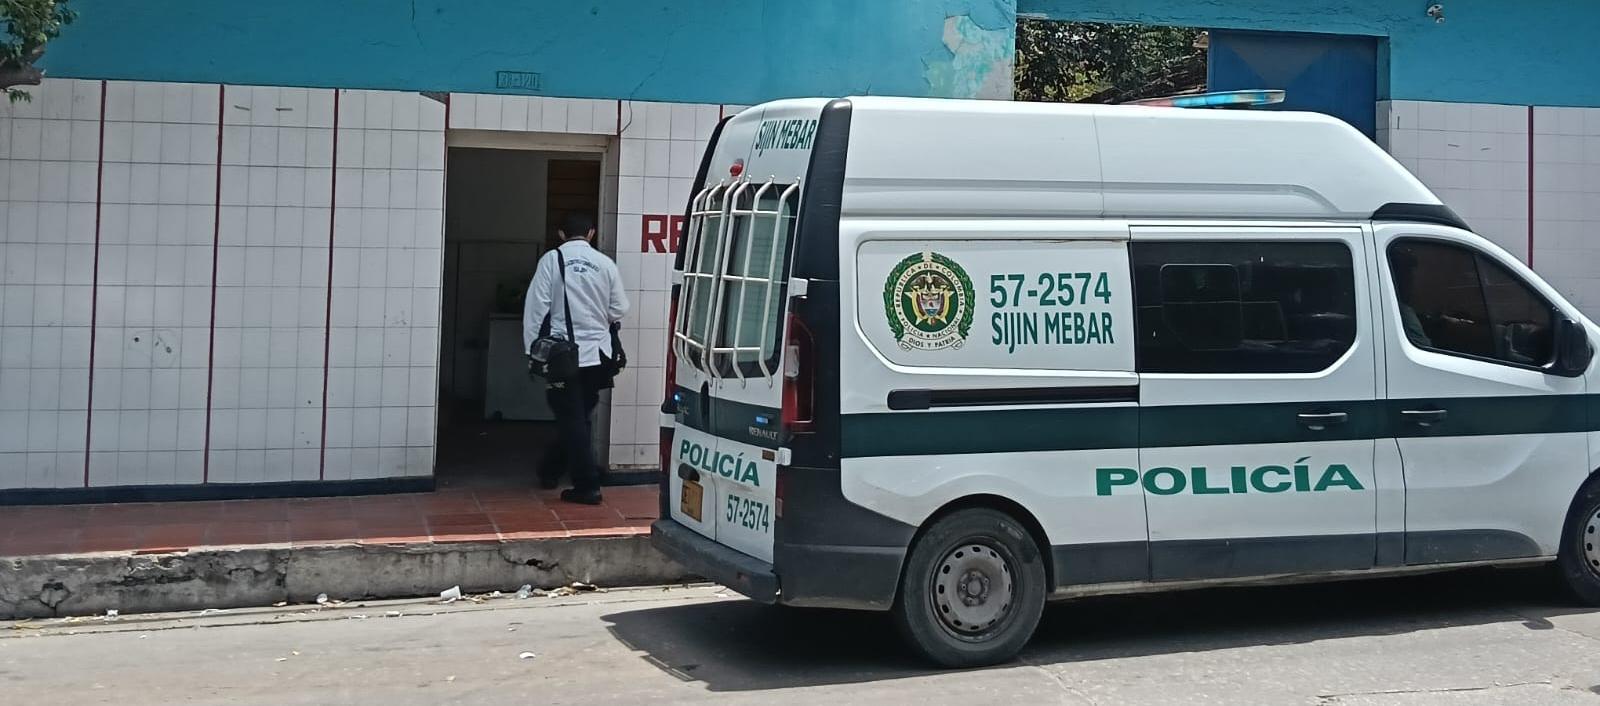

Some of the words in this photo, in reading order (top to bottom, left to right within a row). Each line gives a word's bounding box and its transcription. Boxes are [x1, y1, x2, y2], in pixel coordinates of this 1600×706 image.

[755, 121, 779, 157] SIJIN
[776, 120, 817, 149] MEBAR
[941, 267, 965, 306] COLOMBIA
[990, 272, 1112, 308] 57-2574
[908, 337, 924, 348] DIOS
[934, 336, 956, 347] PATRIA
[991, 312, 1038, 354] SIJIN
[1044, 312, 1114, 345] MEBAR
[679, 439, 760, 486] POLICÍA
[1096, 456, 1365, 496] POLICÍA
[726, 494, 769, 533] 57-2574
